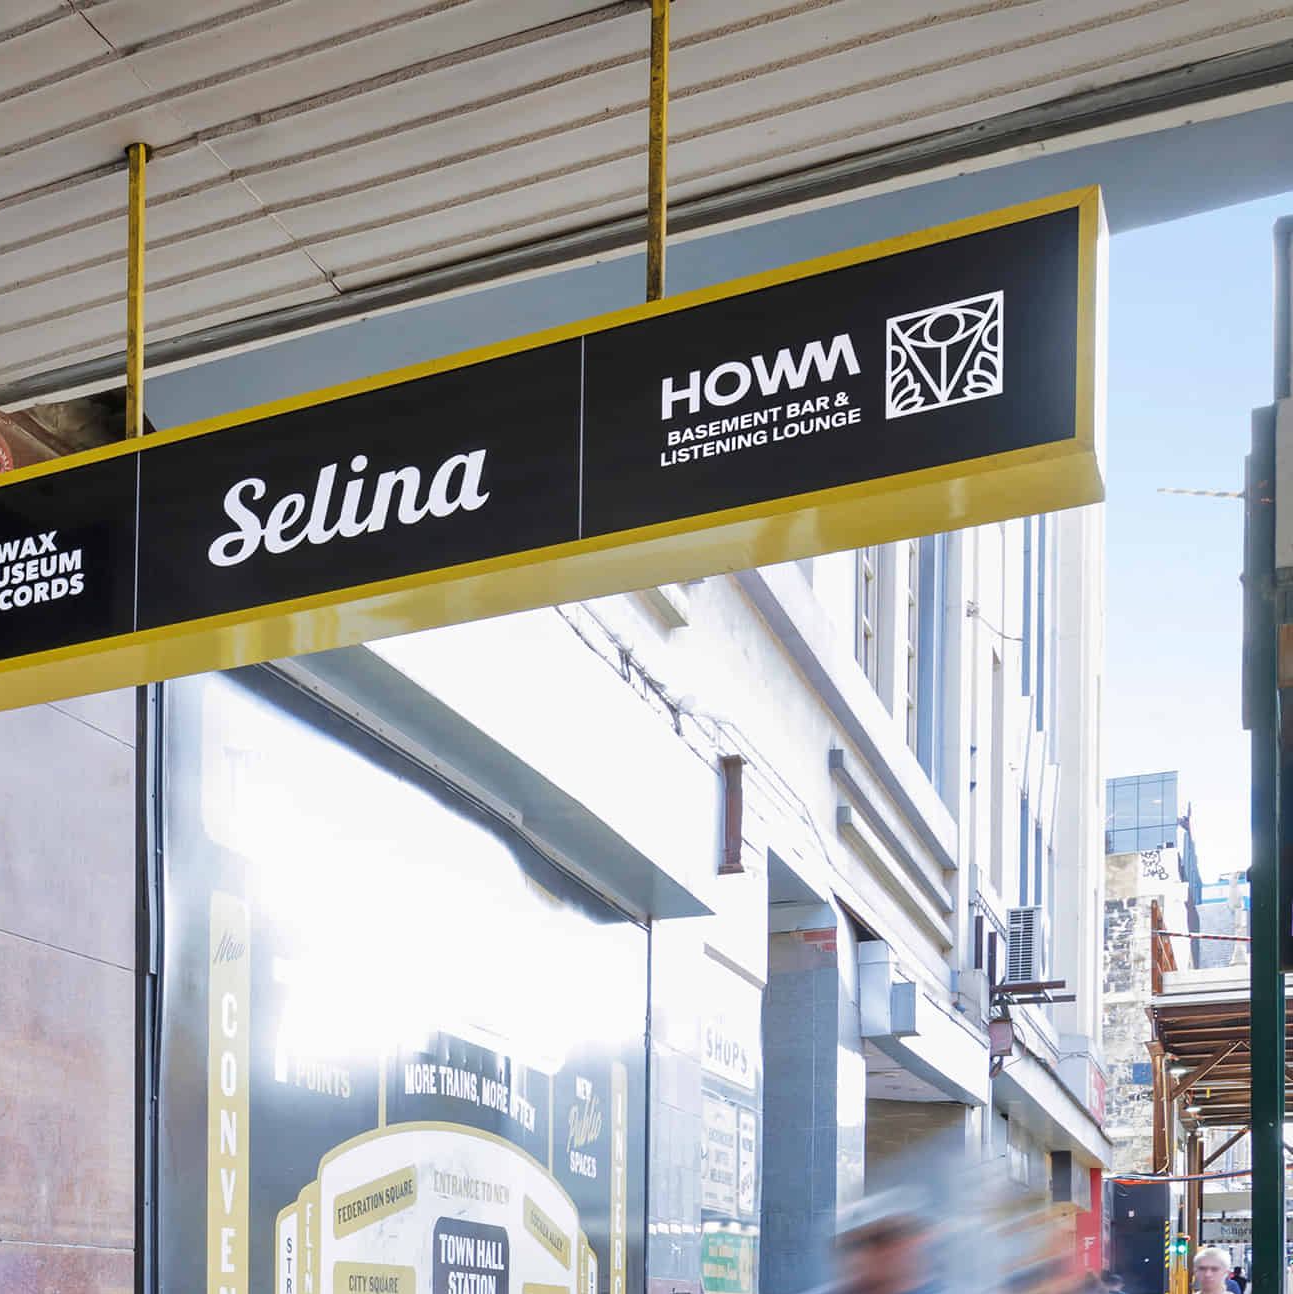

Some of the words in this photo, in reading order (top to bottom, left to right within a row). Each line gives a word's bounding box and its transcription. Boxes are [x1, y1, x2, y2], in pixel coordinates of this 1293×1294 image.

[660, 333, 862, 420] HOWM
[660, 429, 768, 467] LISTENING
[772, 408, 862, 441] LOUNGE
[667, 406, 782, 446] BASEMENT
[786, 394, 831, 419] BAR
[833, 391, 850, 407] &
[208, 446, 490, 568] Selina
[705, 1026, 749, 1074] SHOPS
[404, 1063, 438, 1095] MORE
[439, 1065, 480, 1106] TRAINS,
[481, 1078, 509, 1114] MORE
[575, 1076, 593, 1101] NEW
[570, 1149, 597, 1178] SPACES
[337, 1191, 384, 1225] FEDERATION
[384, 1178, 414, 1206] SQUARE
[439, 1232, 474, 1270] TOWN
[475, 1236, 506, 1272] HALL
[348, 1275, 367, 1294] CITY
